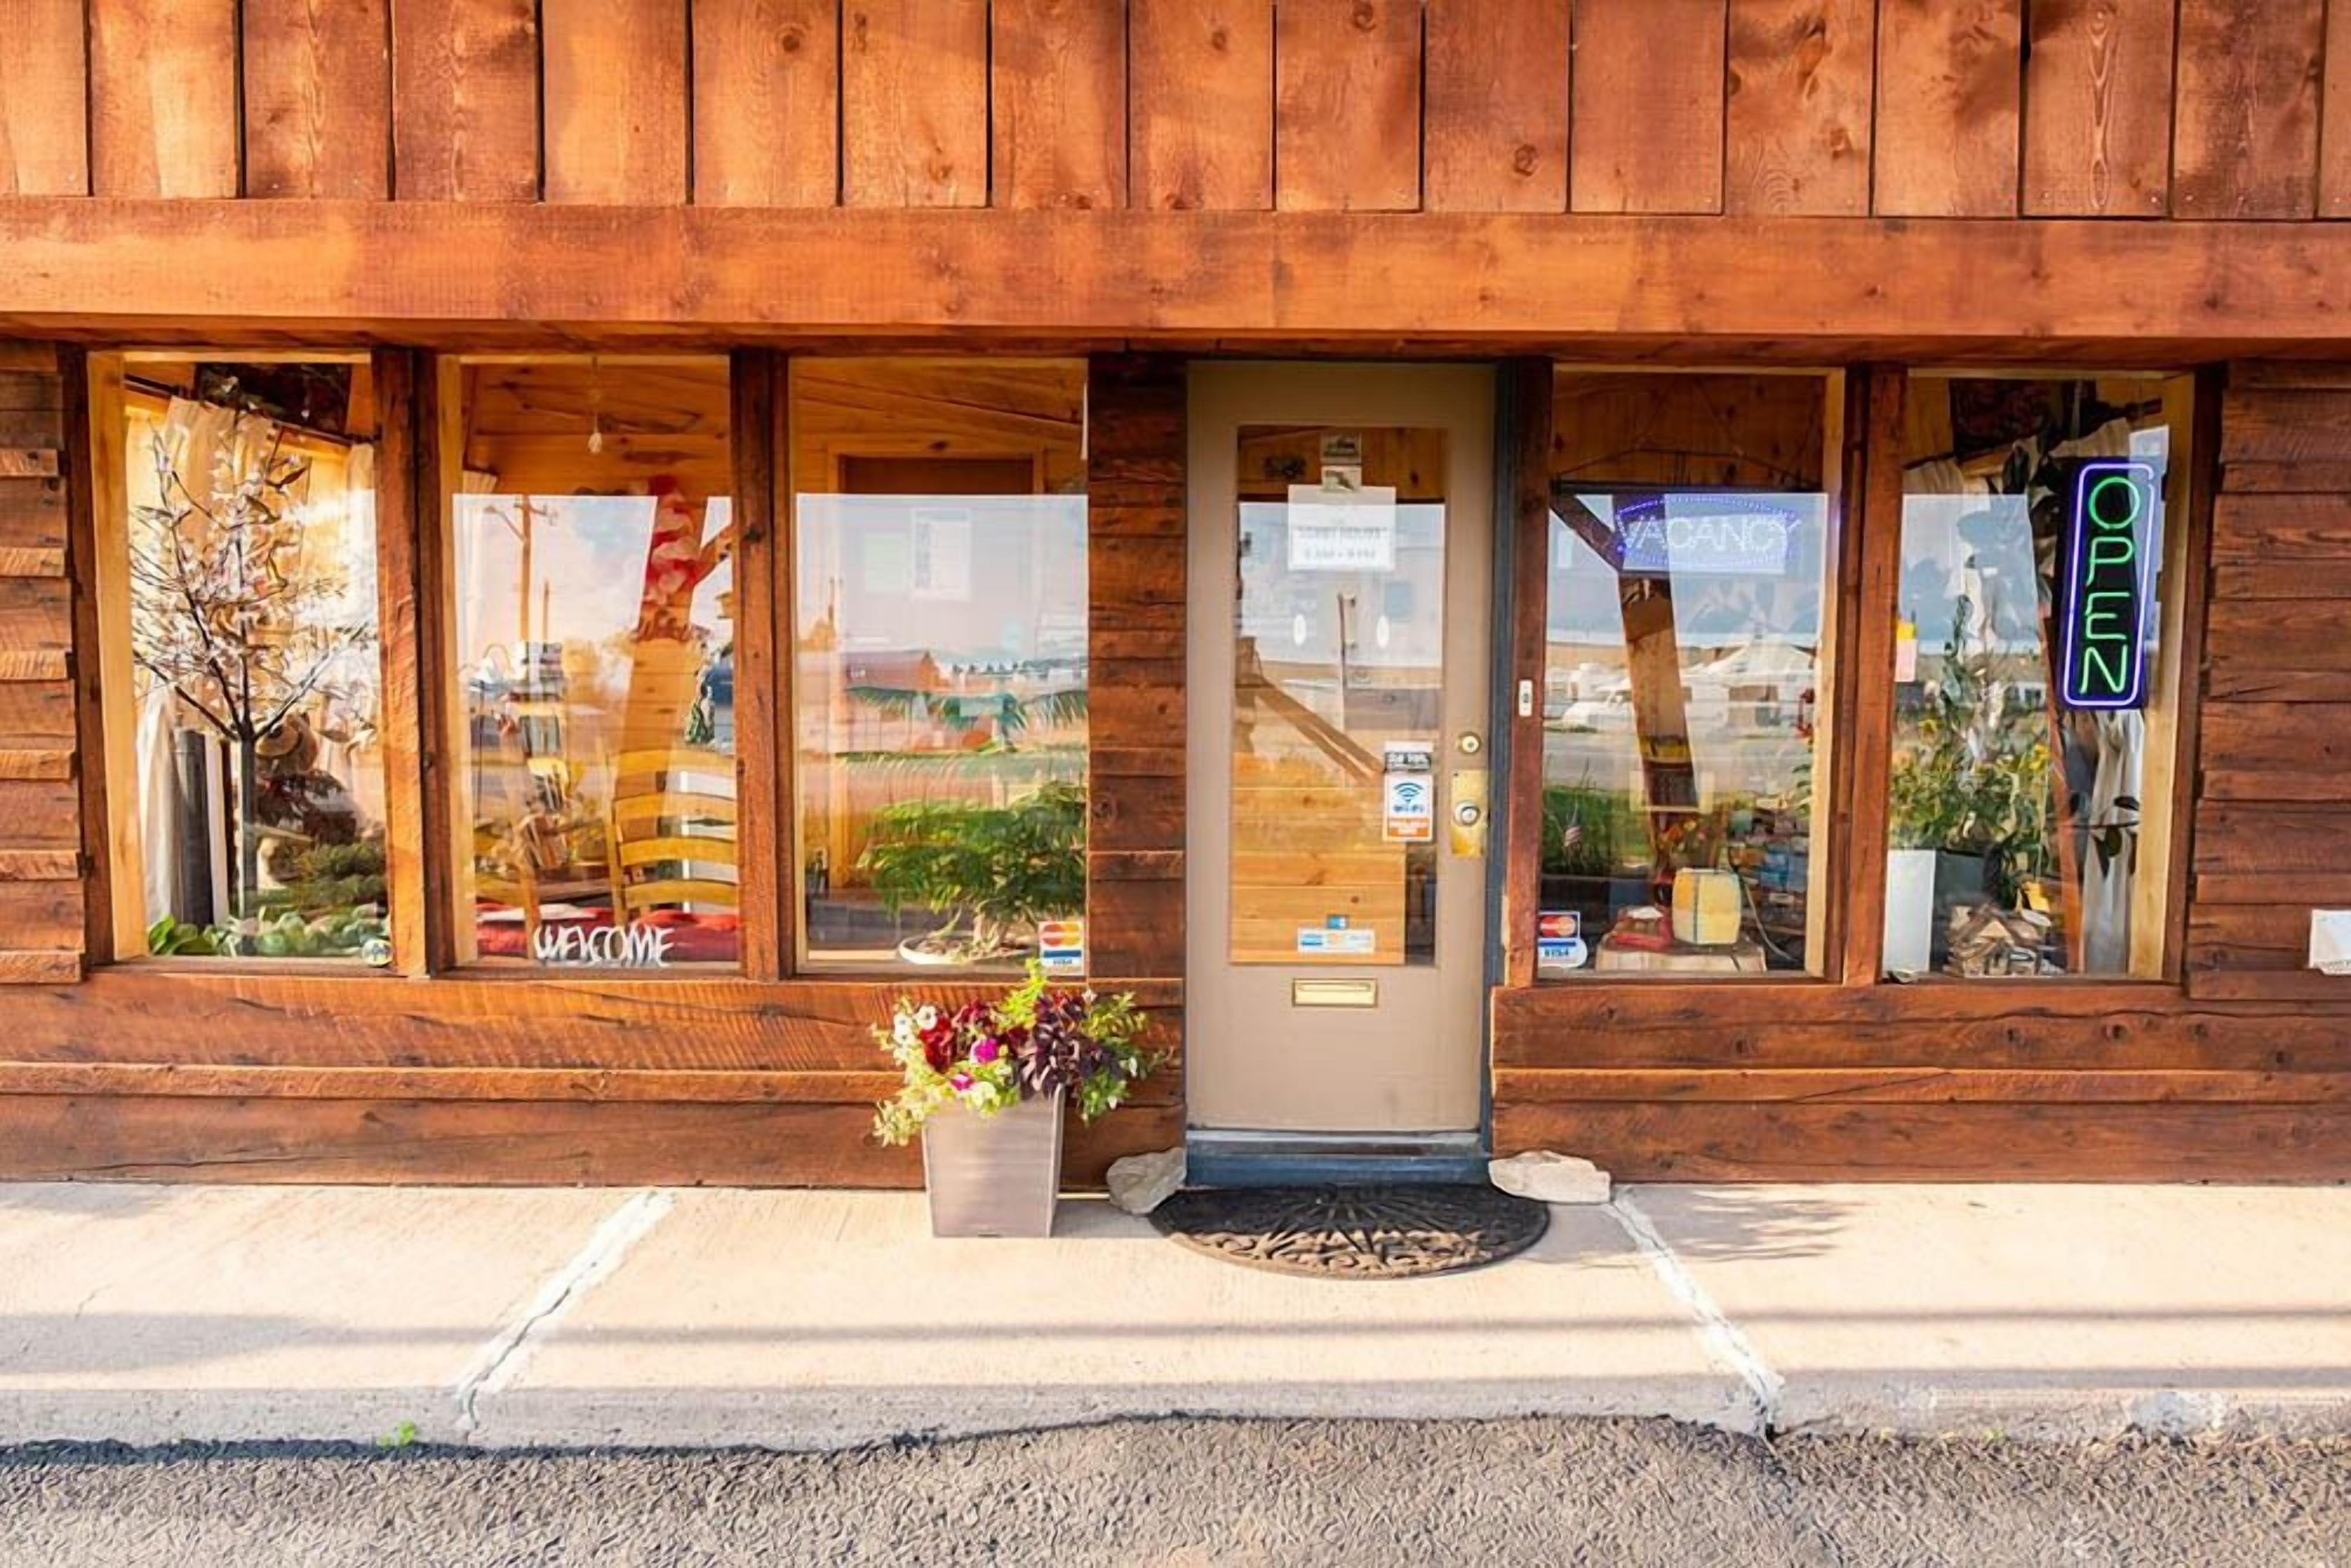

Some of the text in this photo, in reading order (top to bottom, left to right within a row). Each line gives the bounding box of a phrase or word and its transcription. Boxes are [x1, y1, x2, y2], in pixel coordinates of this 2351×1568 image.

[1623, 513, 1803, 551] VACANCY
[2079, 476, 2141, 695] OPEN
[533, 920, 676, 967] WELCOME
